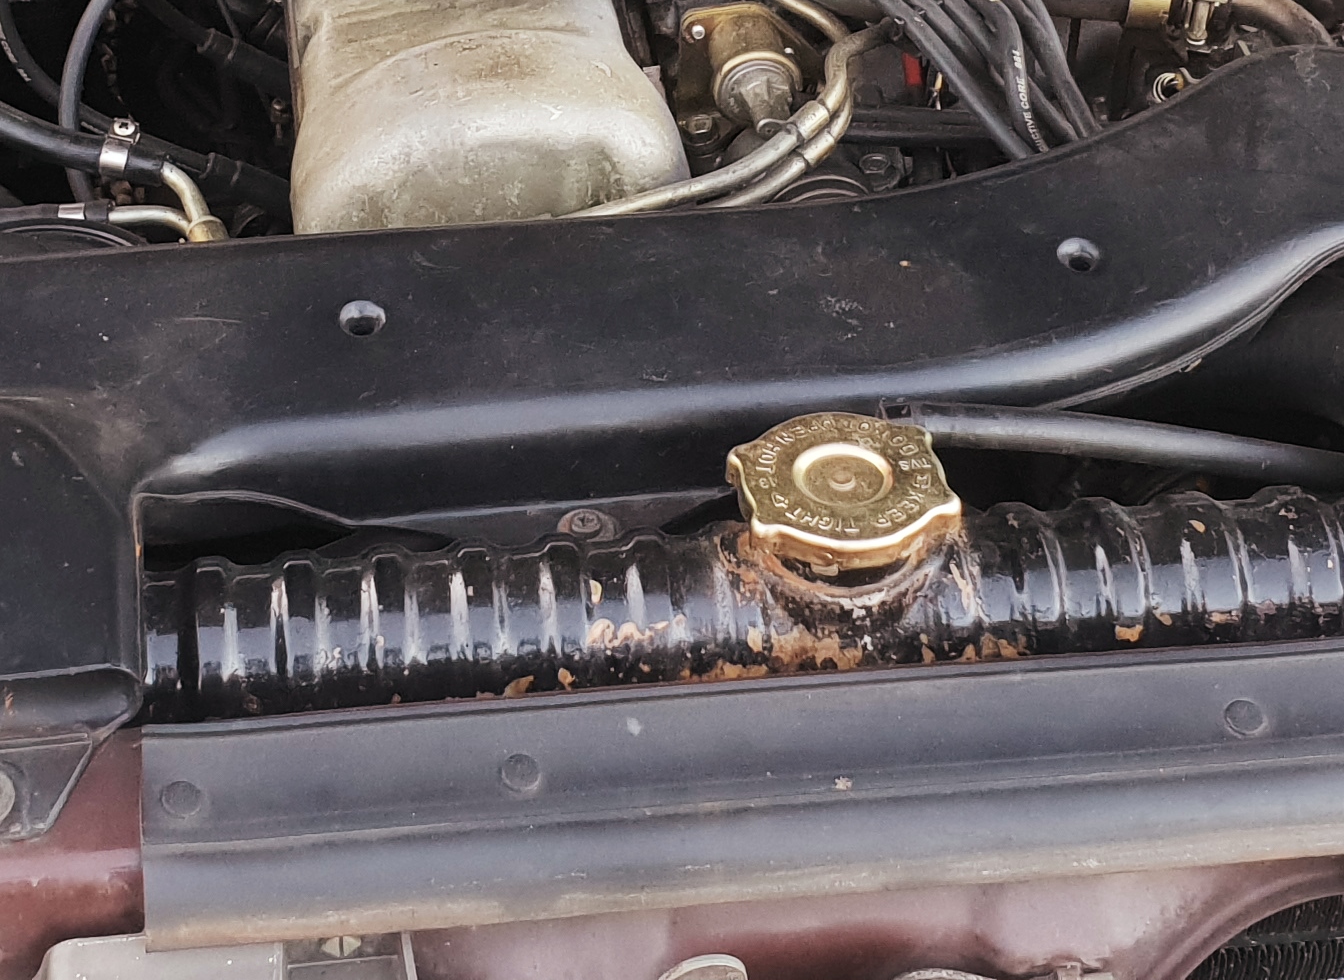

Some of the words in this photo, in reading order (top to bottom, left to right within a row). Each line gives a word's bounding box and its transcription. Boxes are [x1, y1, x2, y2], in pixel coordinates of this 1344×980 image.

[1016, 76, 1030, 110] CORE
[898, 458, 932, 471] TVS
[784, 507, 861, 534] TIGHT
[871, 491, 926, 528] KEEP
